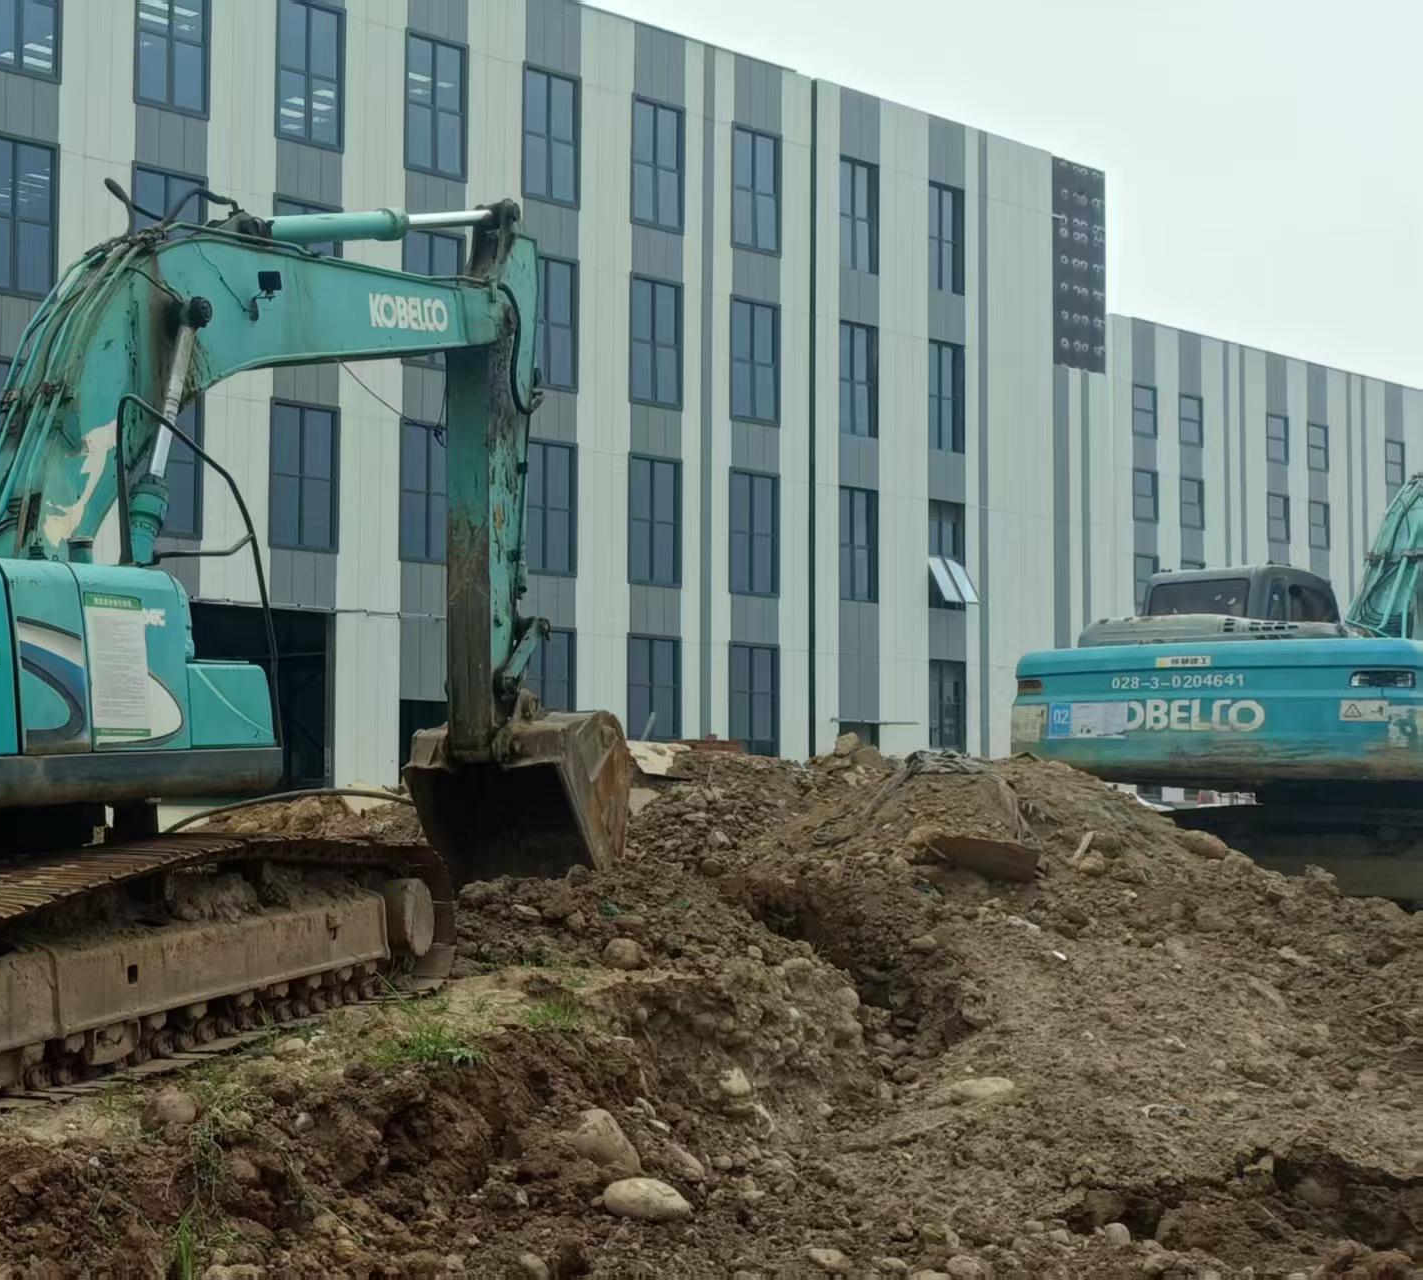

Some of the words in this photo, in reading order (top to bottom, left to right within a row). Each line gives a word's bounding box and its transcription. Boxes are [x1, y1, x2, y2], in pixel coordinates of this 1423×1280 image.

[368, 292, 448, 332] KOBELCO
[1112, 674, 1244, 690] 028-3-0204641
[1053, 709, 1069, 724] 02
[1126, 699, 1265, 732] OBELCO
